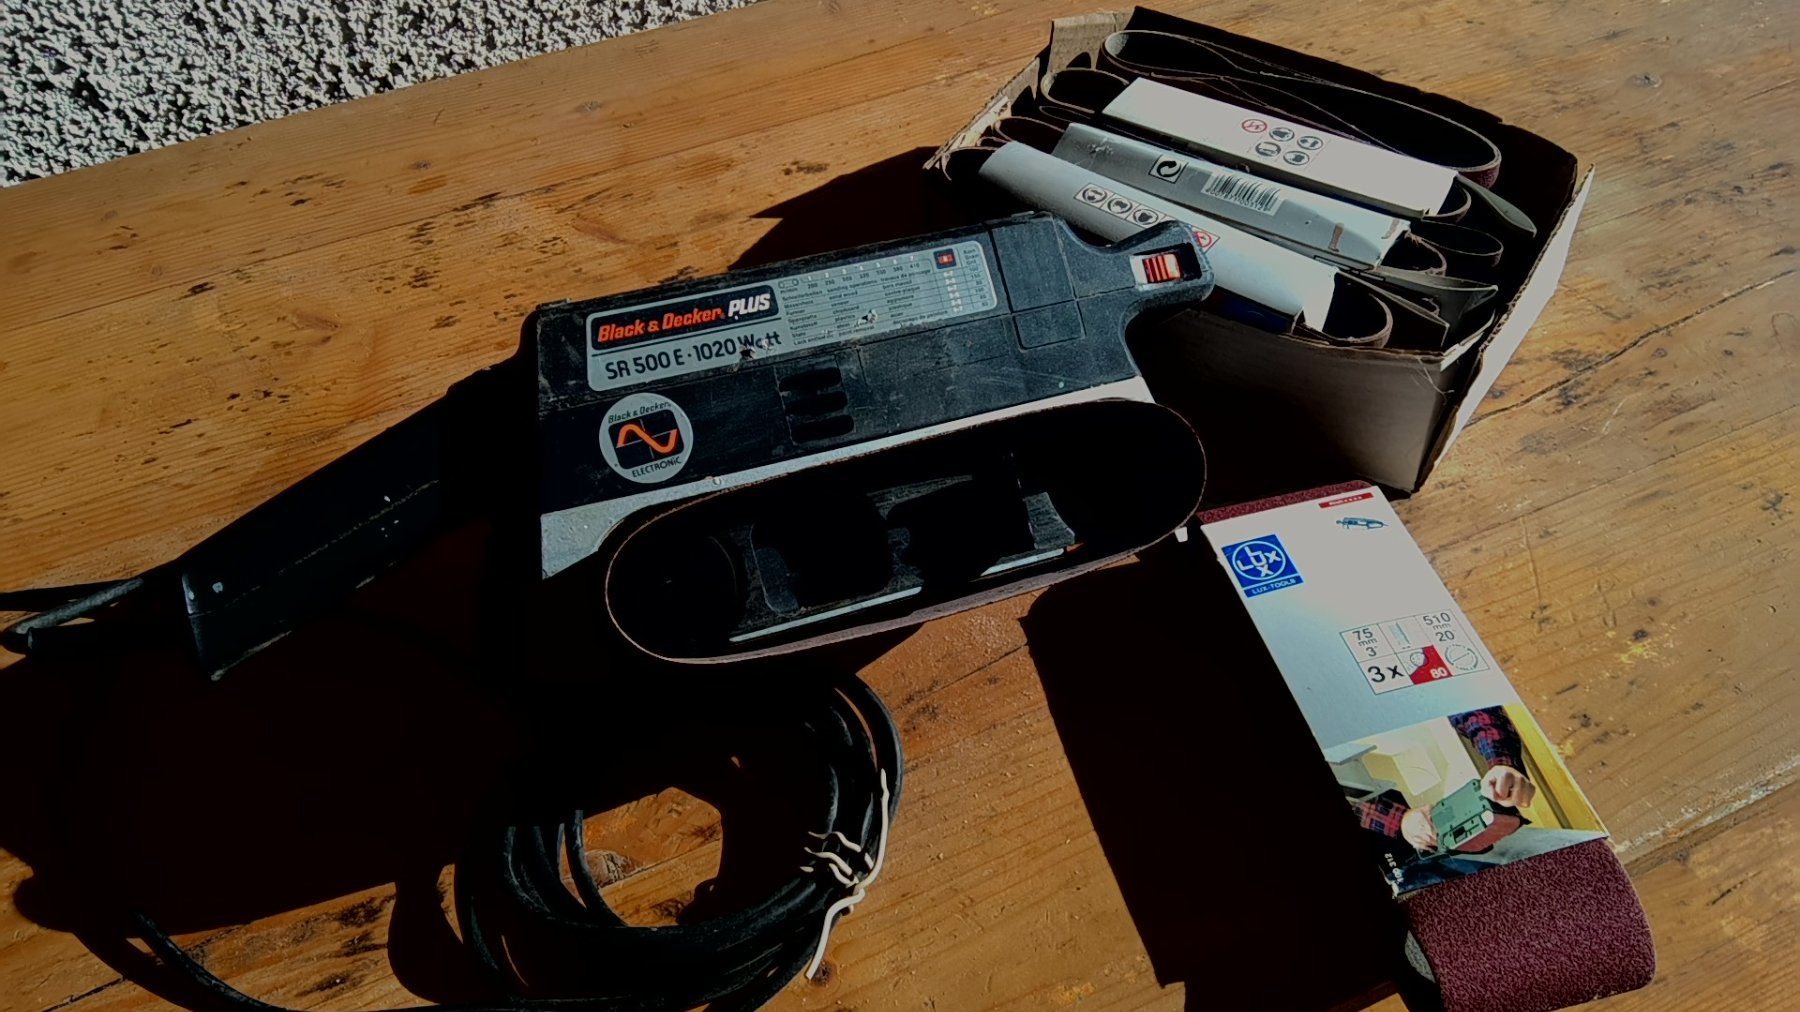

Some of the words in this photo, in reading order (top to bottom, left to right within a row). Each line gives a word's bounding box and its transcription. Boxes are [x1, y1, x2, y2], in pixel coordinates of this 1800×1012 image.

[597, 320, 645, 343] Black
[647, 320, 659, 332] &
[662, 307, 723, 330] Decker
[728, 293, 771, 317] PLUS
[605, 360, 630, 380] SR
[633, 351, 671, 374] 500
[608, 410, 631, 423] Black
[640, 402, 669, 414] Decker
[1251, 578, 1296, 595] LUX-TOOLS
[1423, 612, 1451, 626] 510
[1432, 622, 1451, 630] mm
[1352, 627, 1374, 641] 75
[1358, 638, 1378, 647] mm
[1430, 667, 1448, 679] 80
